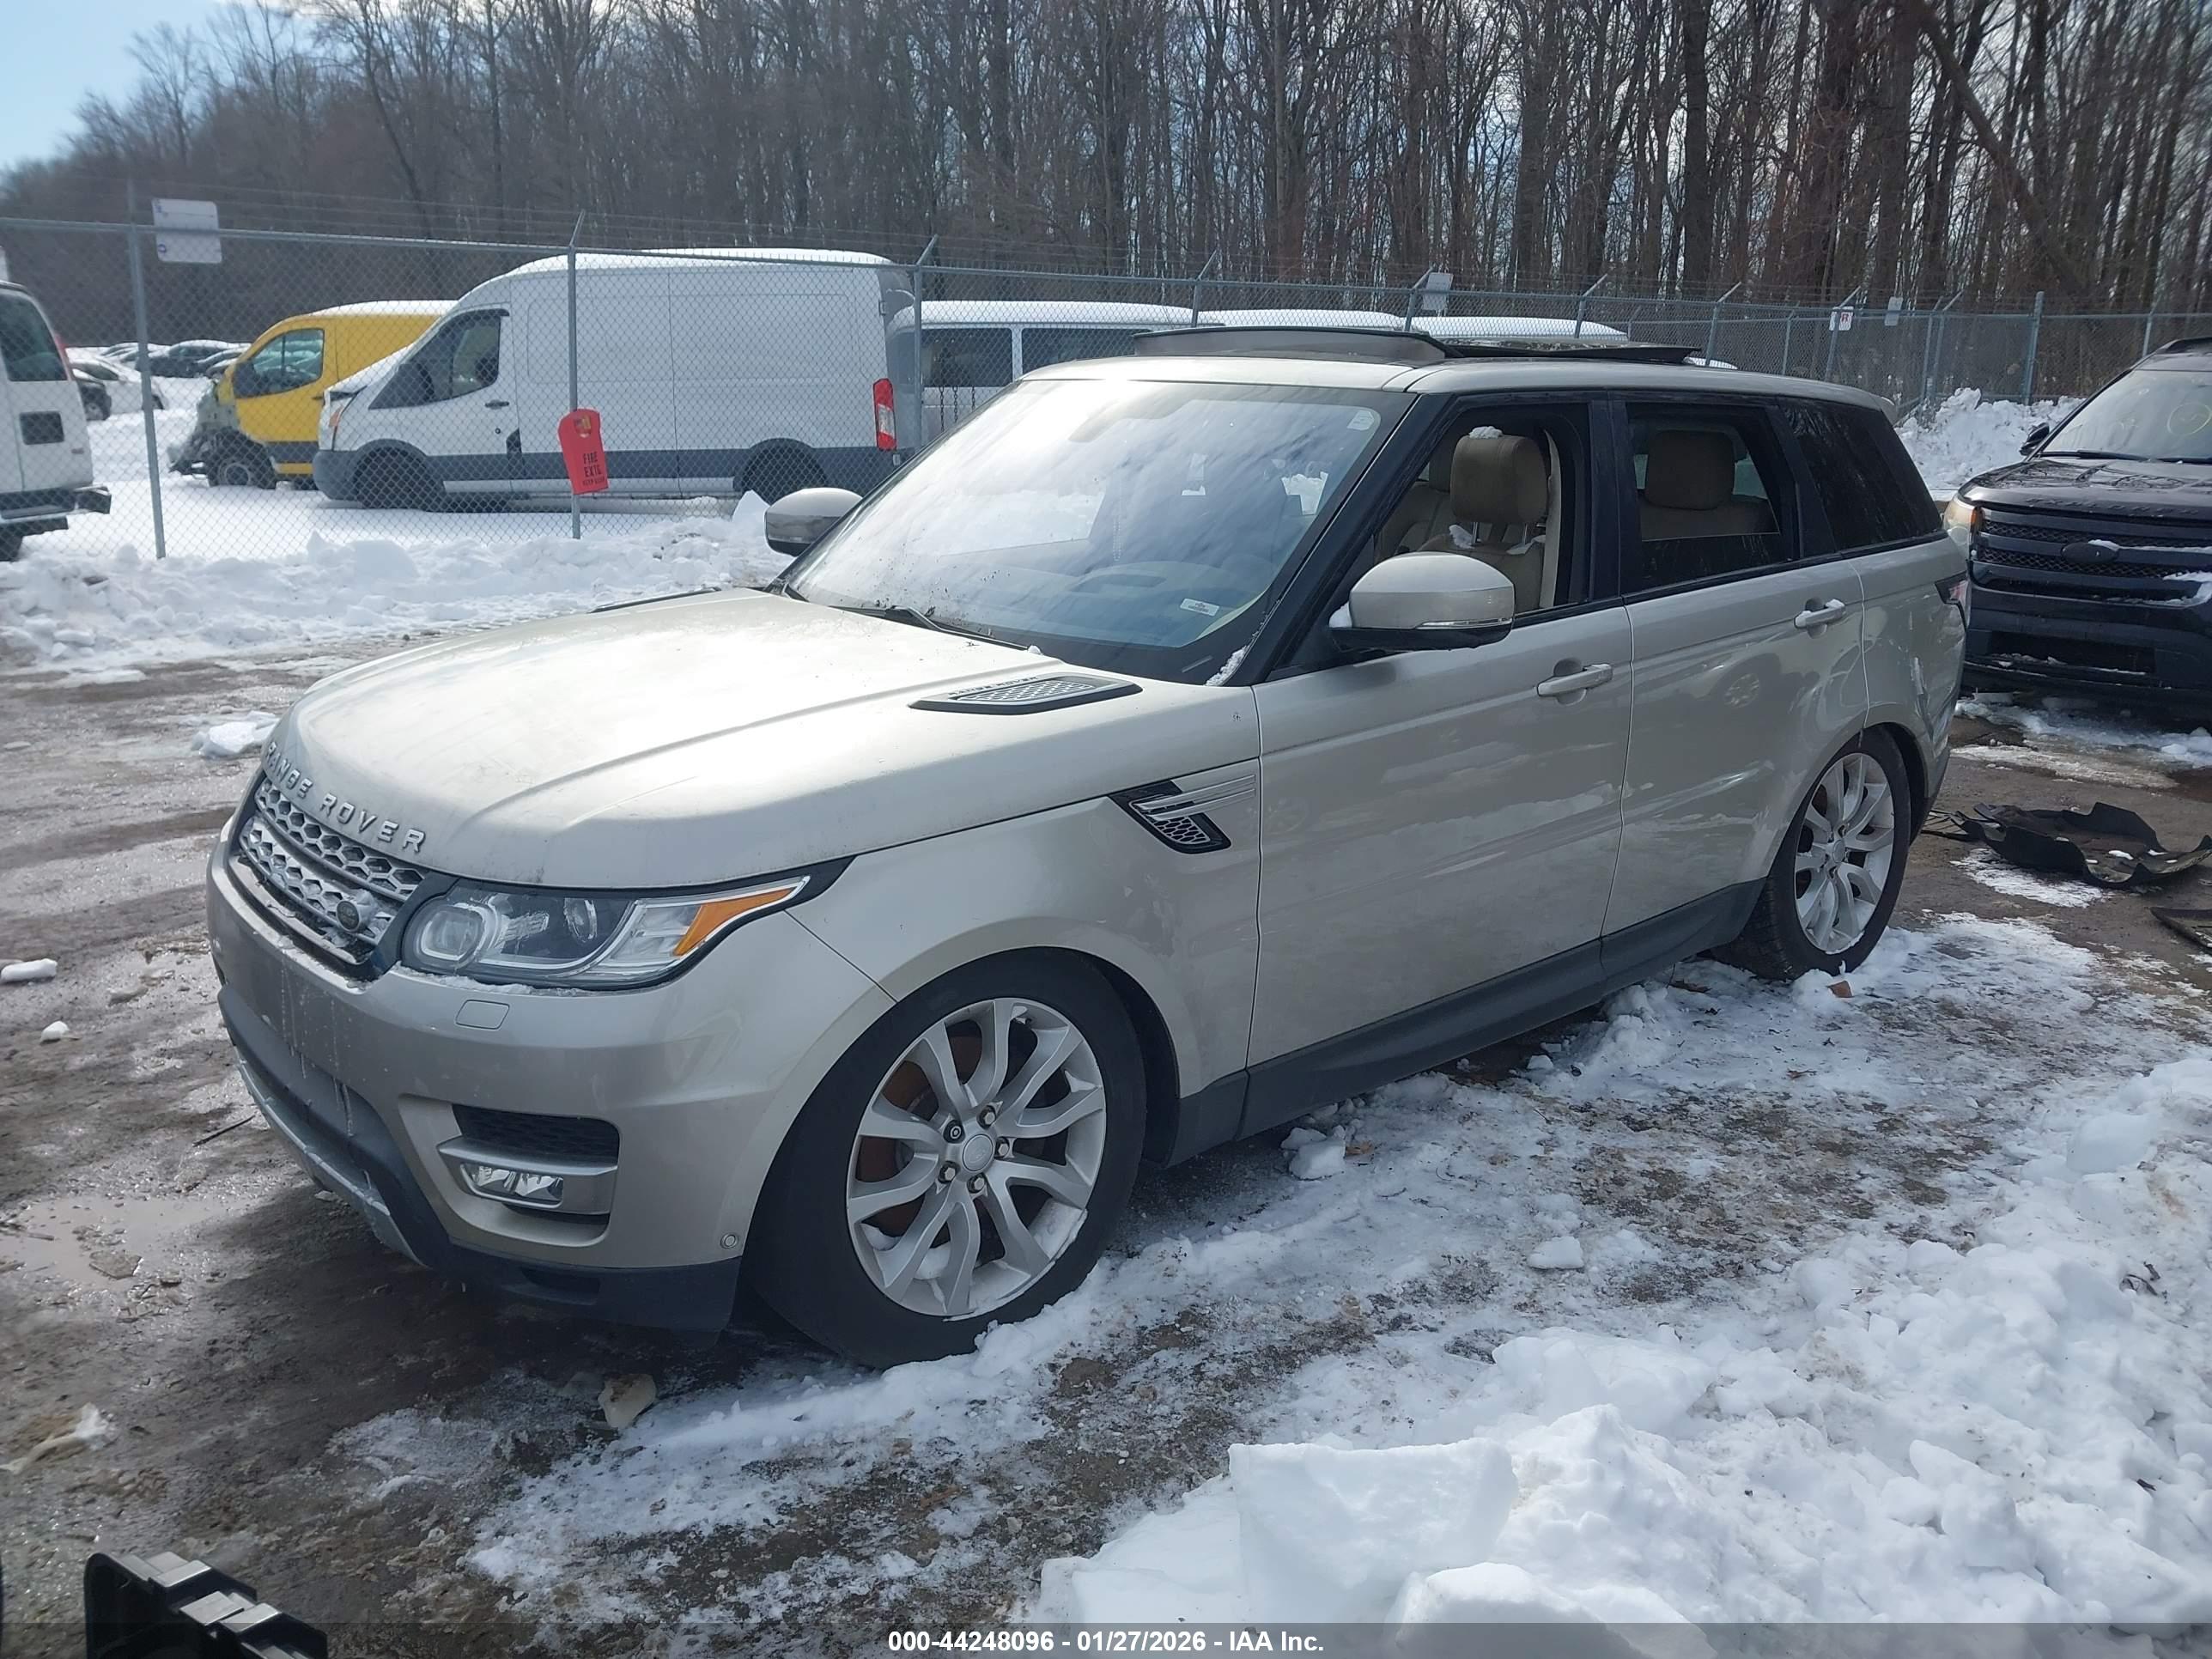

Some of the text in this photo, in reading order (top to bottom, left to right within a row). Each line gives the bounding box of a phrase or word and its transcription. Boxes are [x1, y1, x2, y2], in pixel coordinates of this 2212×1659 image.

[582, 451, 599, 465] FIRE
[266, 741, 426, 854] RANGE ROVER
